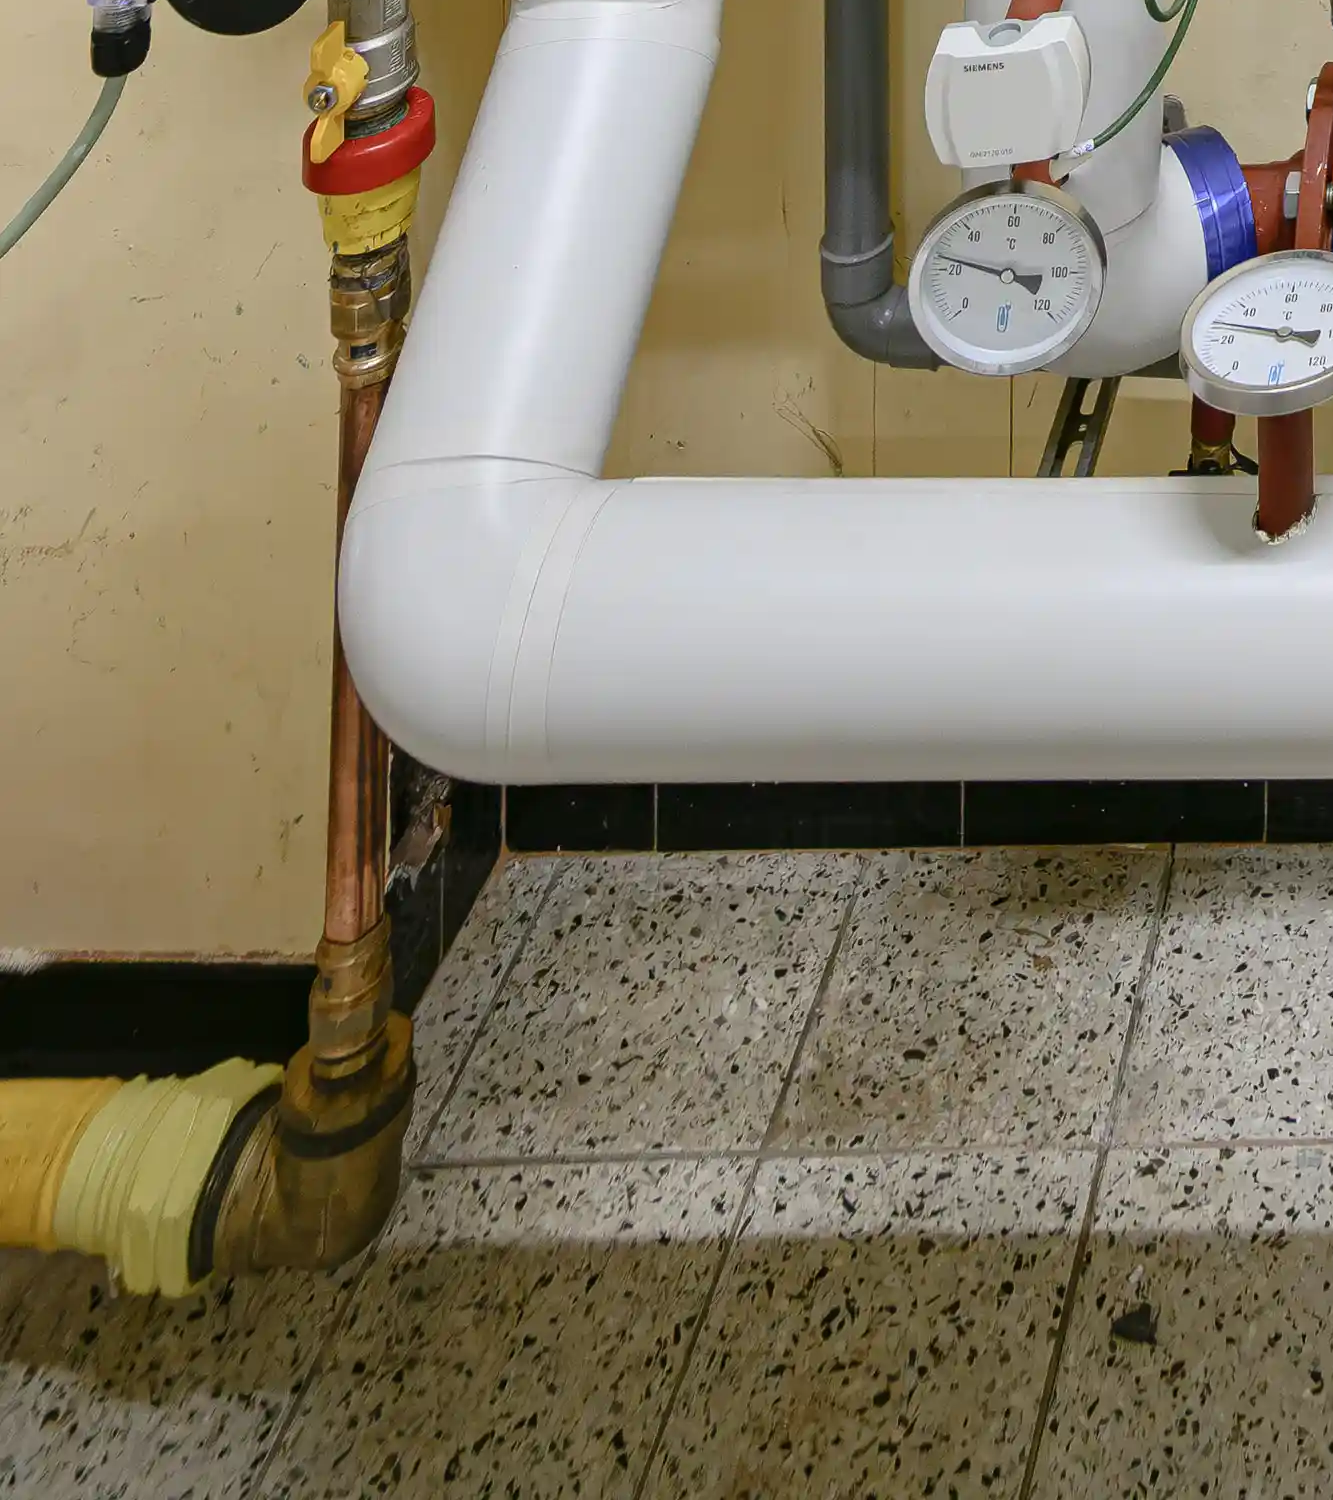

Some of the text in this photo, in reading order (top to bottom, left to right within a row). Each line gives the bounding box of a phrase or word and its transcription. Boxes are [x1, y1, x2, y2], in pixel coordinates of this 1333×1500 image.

[963, 62, 1005, 73] SIEMENS
[1008, 216, 1020, 227] 60
[968, 231, 980, 242] 40
[1043, 233, 1054, 244] 80
[948, 265, 962, 276] 20
[1052, 267, 1067, 278] 100
[963, 297, 968, 308] 0
[1285, 294, 1297, 303] 60
[1034, 299, 1050, 310] 120
[1321, 304, 1332, 312] 80
[1243, 308, 1256, 316] 40
[1221, 335, 1234, 345] 20
[1232, 361, 1238, 370] 0
[1309, 357, 1326, 366] 120
